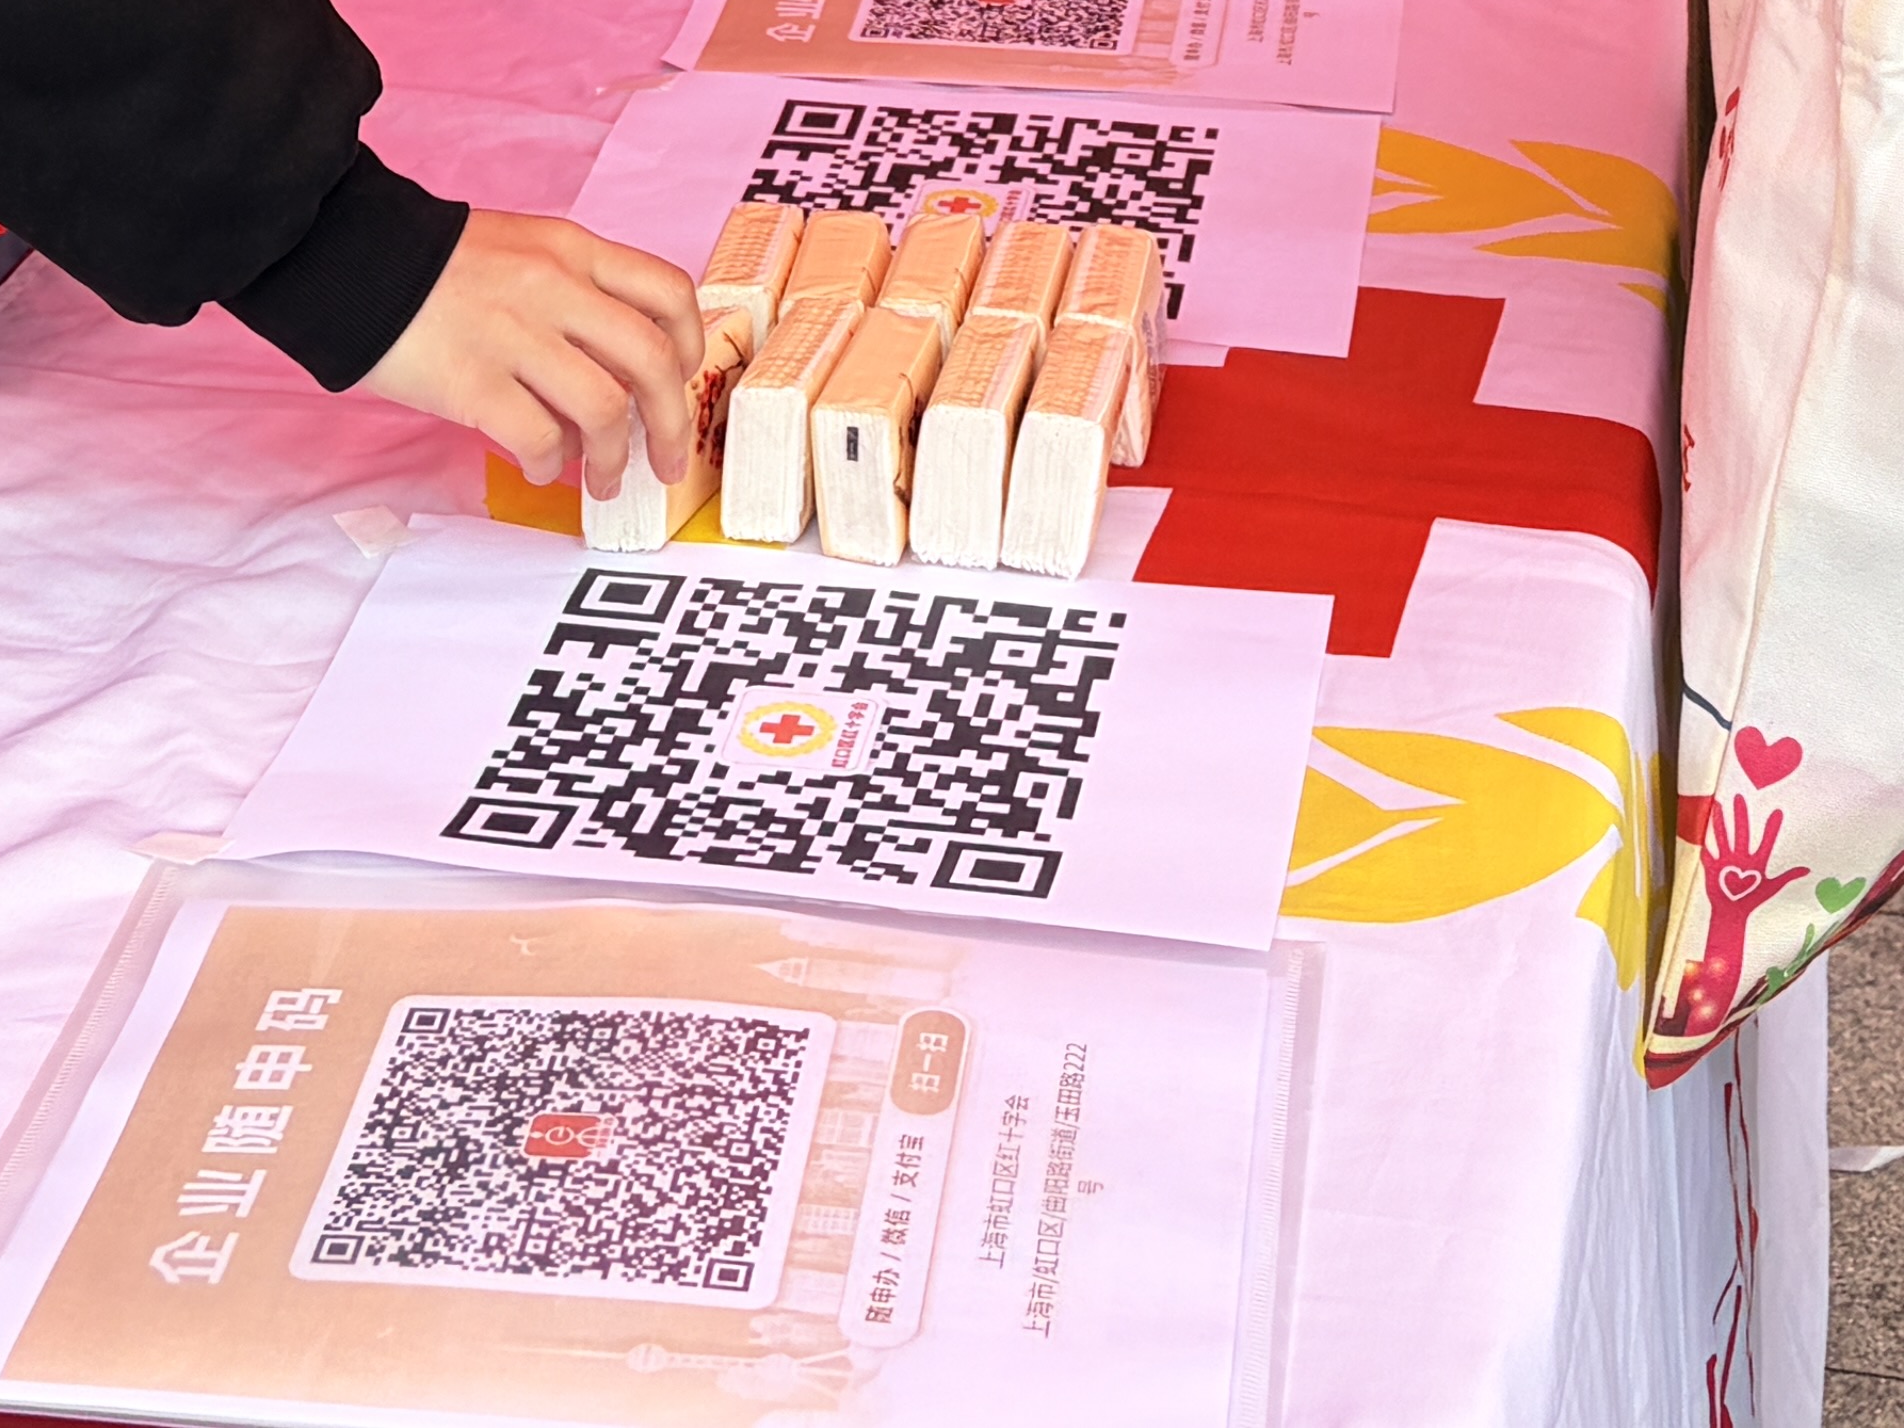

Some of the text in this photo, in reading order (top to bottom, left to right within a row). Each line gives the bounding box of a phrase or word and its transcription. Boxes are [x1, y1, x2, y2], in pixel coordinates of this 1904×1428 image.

[149, 988, 343, 1284] 企业随申码
[908, 1032, 949, 1094] 扫一扫
[978, 1094, 1030, 1270] 上海市虹口区红十字会
